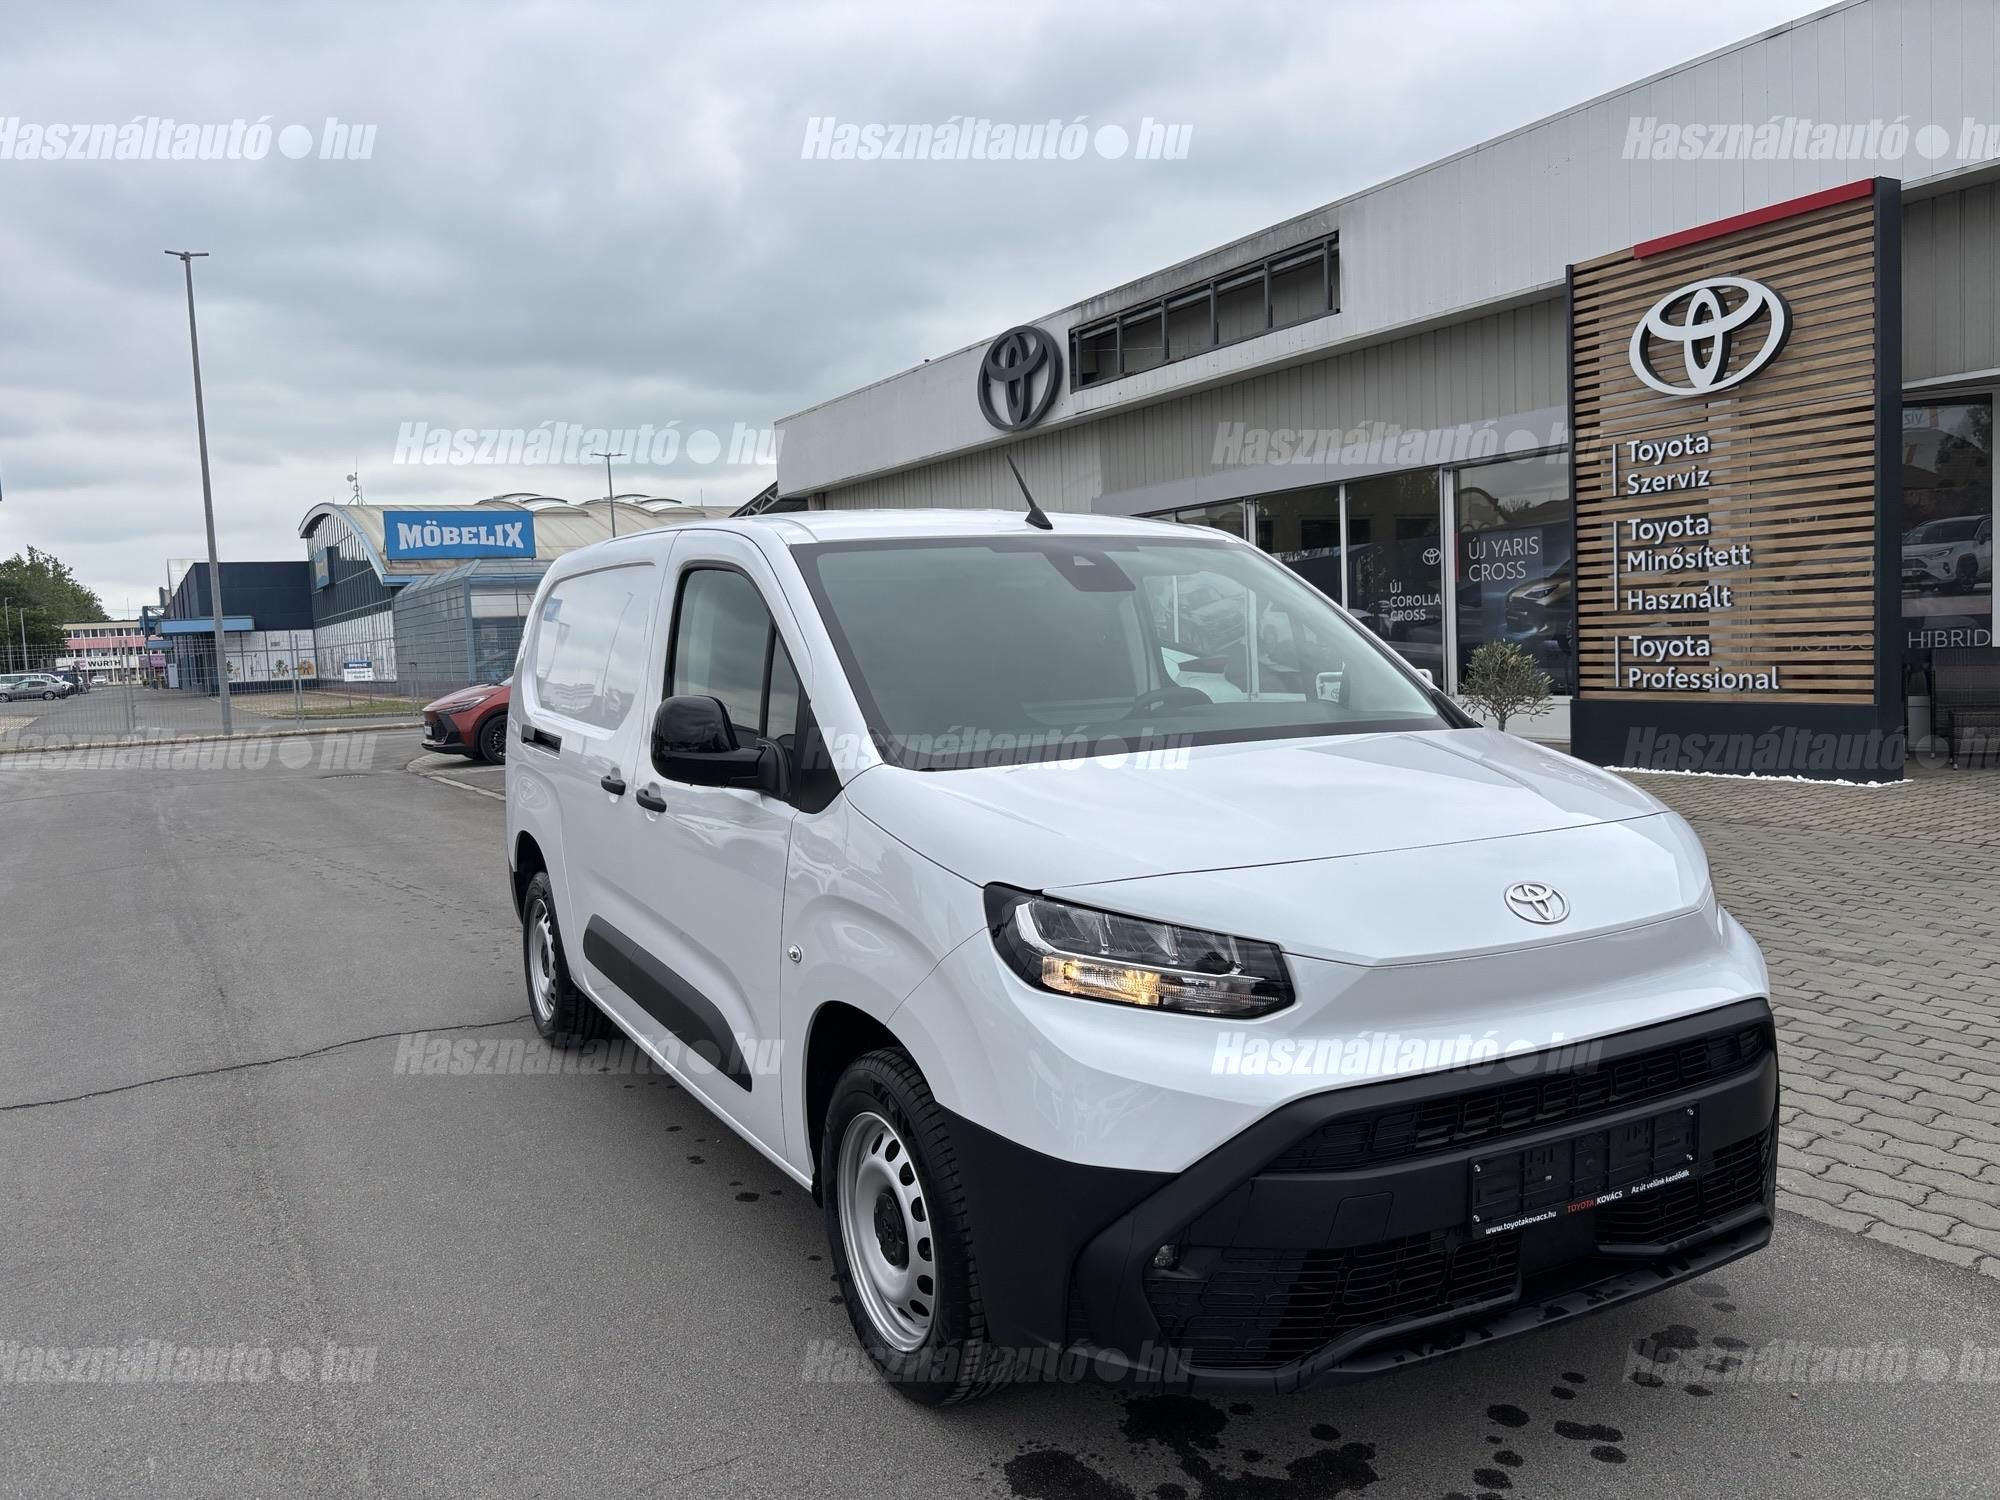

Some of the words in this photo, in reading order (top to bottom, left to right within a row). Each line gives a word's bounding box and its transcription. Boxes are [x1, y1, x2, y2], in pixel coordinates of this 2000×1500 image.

[1627, 434, 1709, 465] Toyota
[1627, 466, 1710, 494] Szerviz
[397, 520, 524, 550] MÖBELIX
[1627, 515, 1709, 544] Toyota
[1468, 537, 1486, 560] ÚJ
[1491, 536, 1539, 558] YARIS
[1628, 544, 1750, 572] Minősített
[1468, 561, 1526, 582] CROSS
[1390, 579, 1401, 593] ÚJ
[1628, 585, 1731, 610] Használt
[1390, 595, 1441, 608] COROLLA
[1390, 609, 1426, 621] CROSS
[1629, 635, 1710, 662] Toyota
[1908, 629, 1991, 649] HIBRID
[1629, 666, 1779, 690] Professional
[1485, 1211, 1557, 1234] www.toyotakovacs.hu
[1567, 1200, 1595, 1213] TOYOTA
